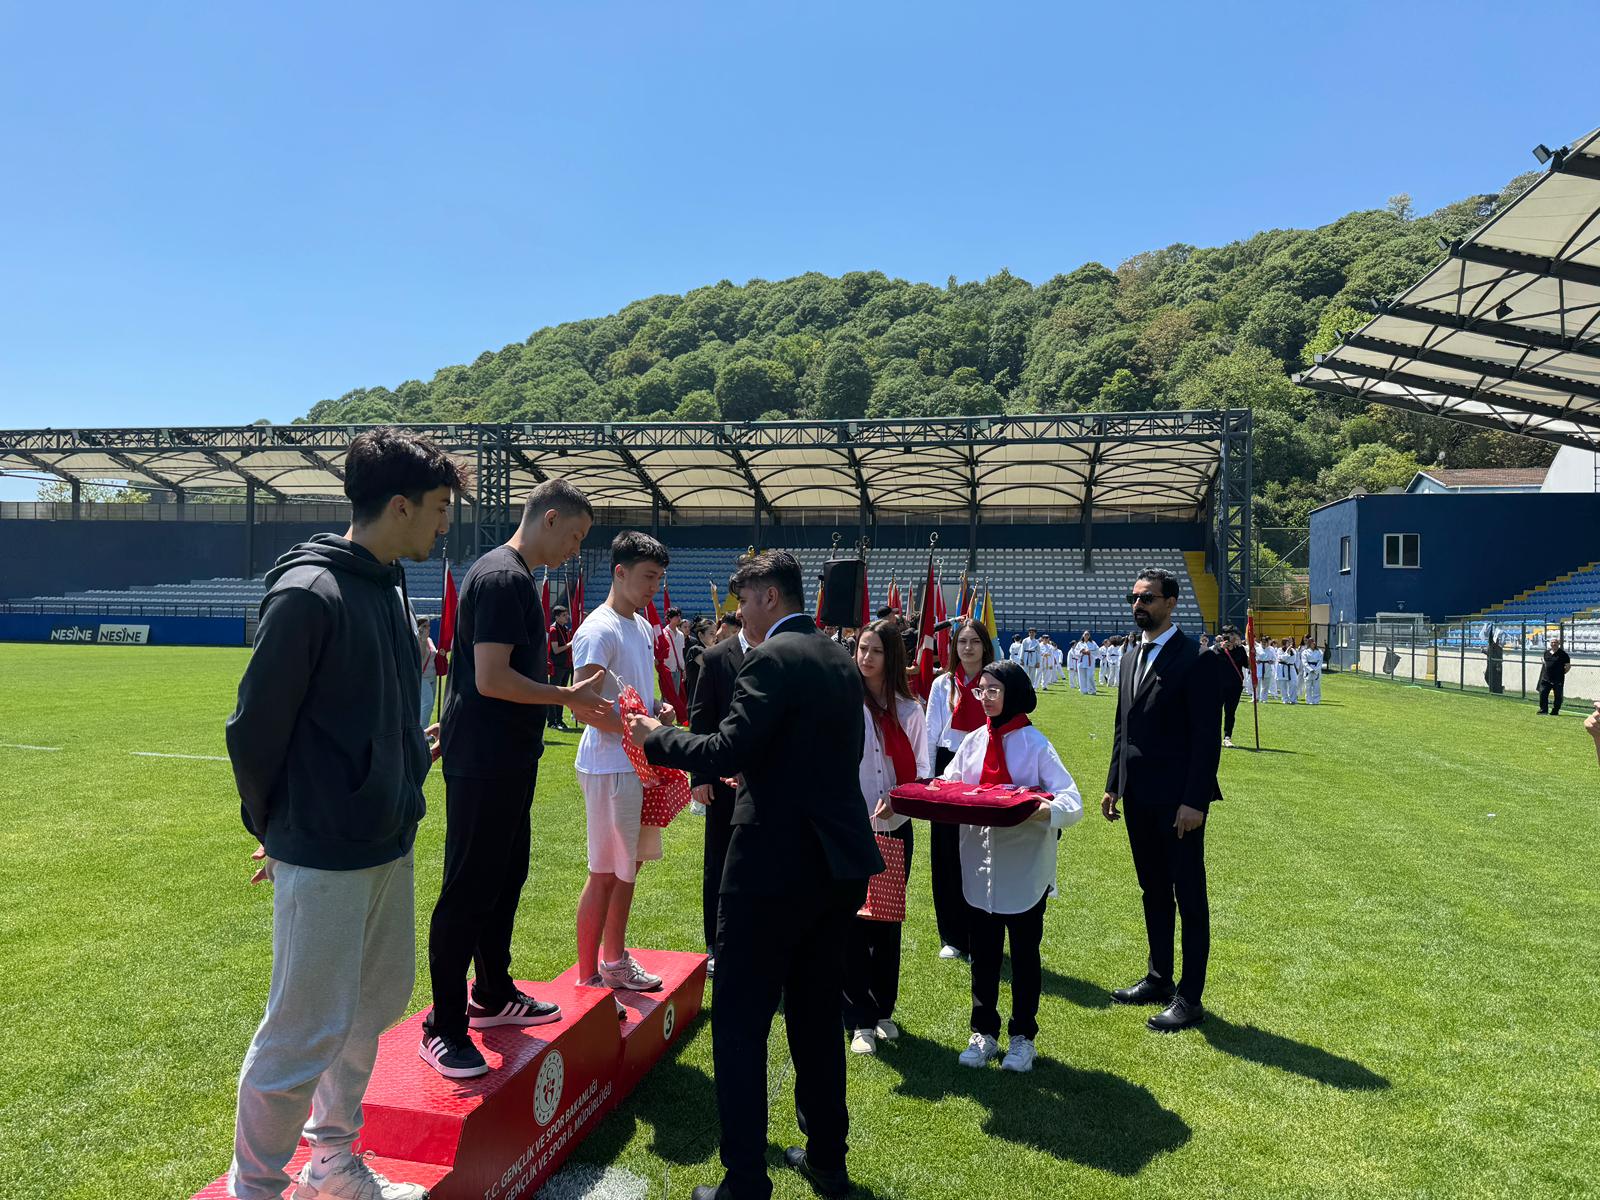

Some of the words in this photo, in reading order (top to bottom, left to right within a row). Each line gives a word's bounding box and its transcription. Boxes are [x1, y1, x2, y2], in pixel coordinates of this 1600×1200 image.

[665, 1009, 672, 1035] 3
[501, 1144, 534, 1188] GENÇLİK
[536, 1134, 545, 1152] VE
[546, 1114, 564, 1142] SPOR
[565, 1078, 598, 1123] BAKANLIĞI
[504, 1162, 537, 1200] GENÇLİK
[538, 1152, 548, 1170] VE
[549, 1132, 567, 1160] SPOR
